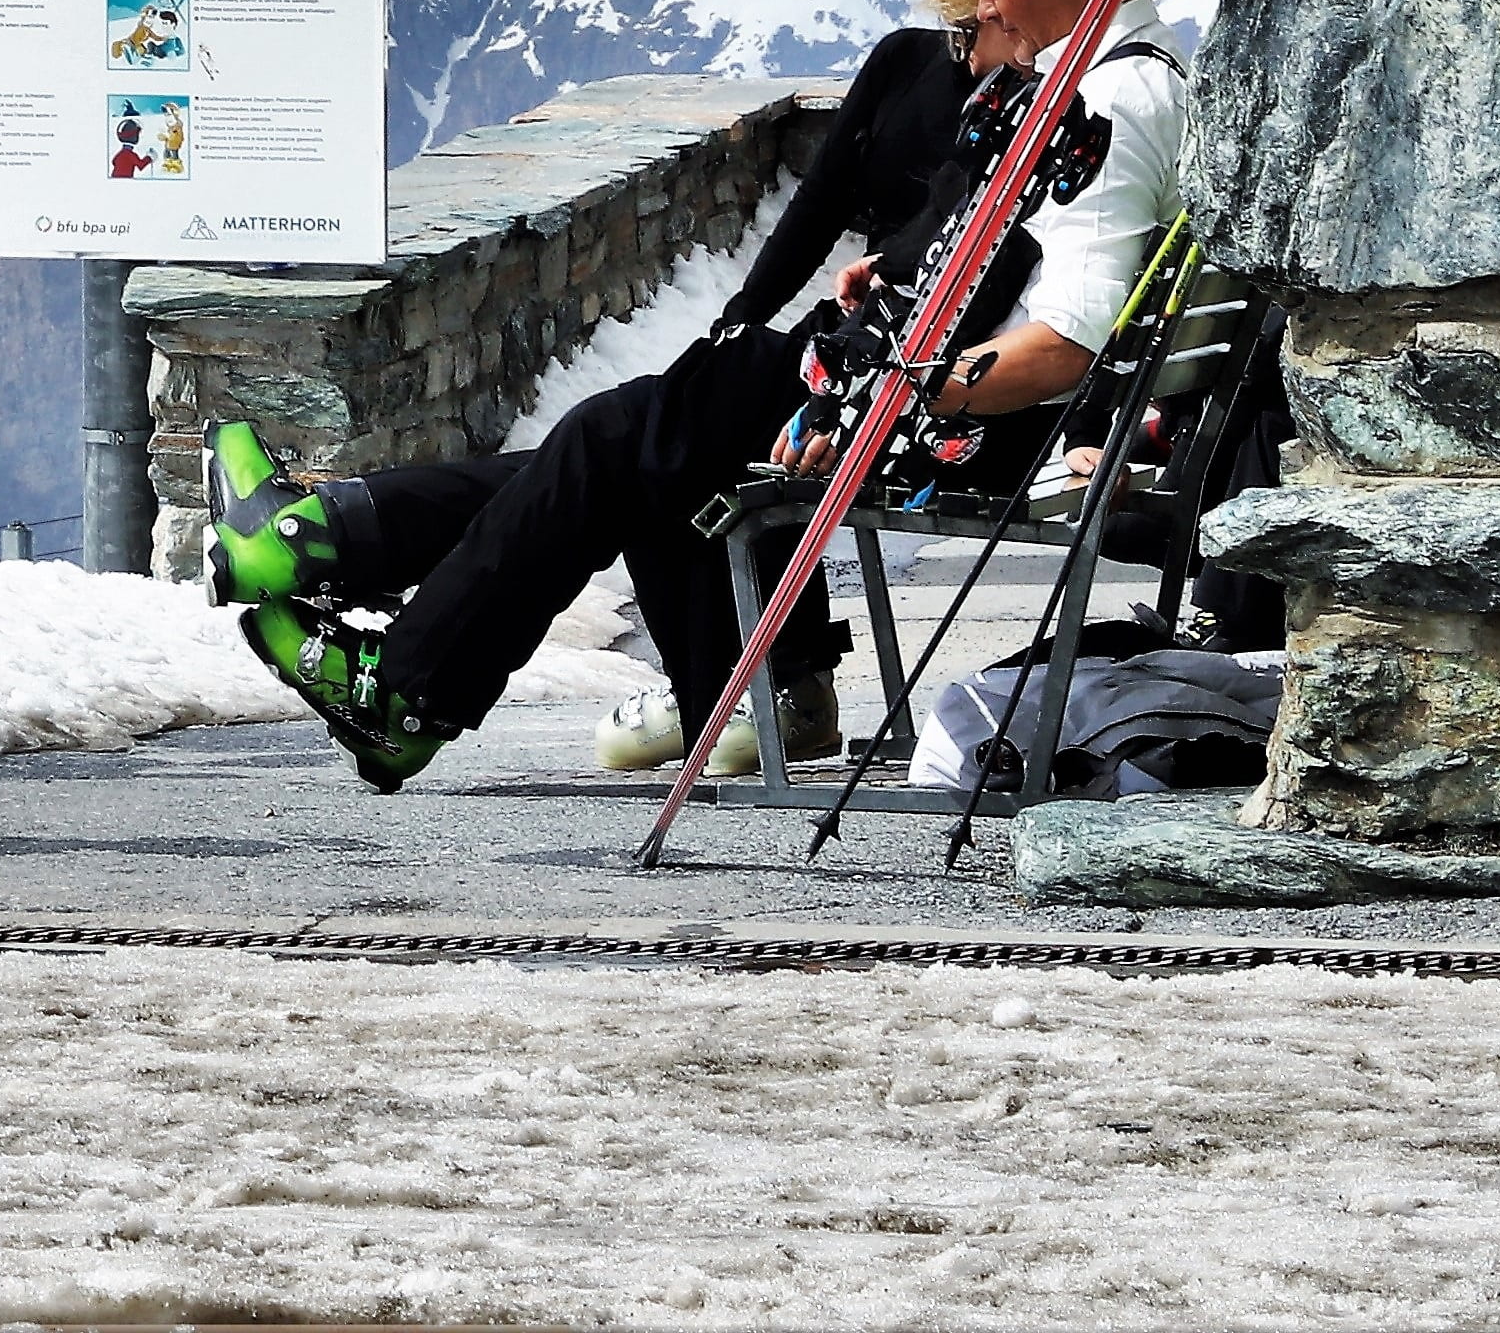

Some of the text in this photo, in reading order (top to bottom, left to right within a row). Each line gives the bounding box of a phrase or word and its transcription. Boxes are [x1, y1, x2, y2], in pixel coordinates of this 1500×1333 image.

[57, 221, 130, 236] bfu bpa upi
[223, 217, 340, 231] MATTERHORN
